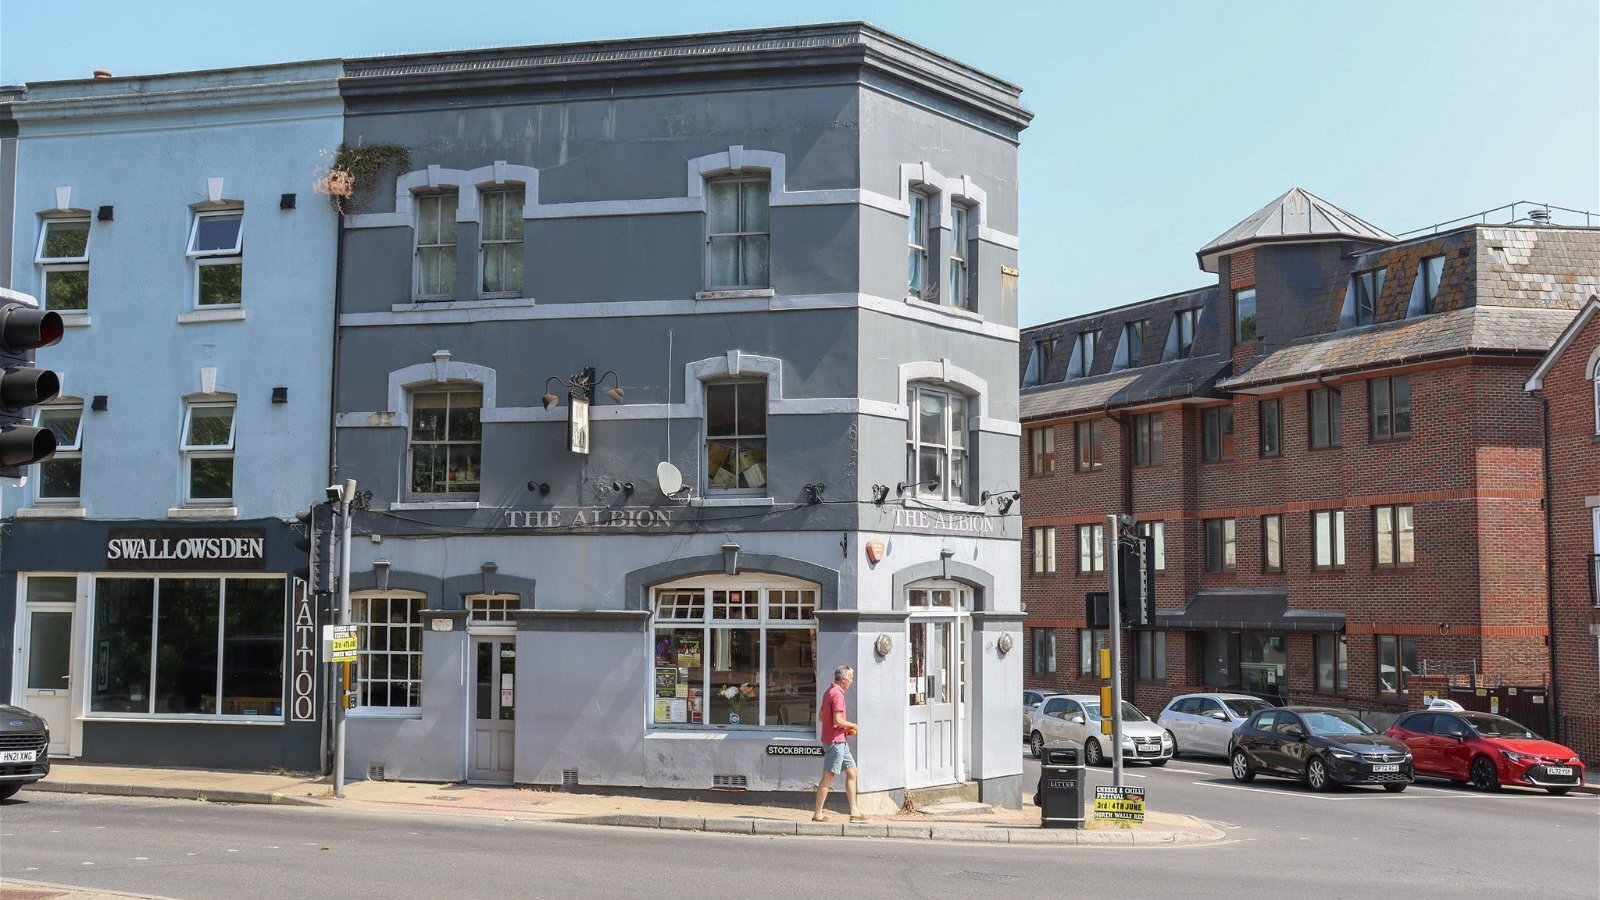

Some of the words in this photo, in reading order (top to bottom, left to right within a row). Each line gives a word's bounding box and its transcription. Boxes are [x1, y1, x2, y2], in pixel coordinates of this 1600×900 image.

[505, 510, 561, 528] THE
[572, 510, 673, 528] ALBION
[892, 507, 930, 528] THE
[934, 512, 994, 532] ALBION
[107, 537, 264, 559] SWALLOWSDEN
[295, 577, 314, 719] TATTOO
[768, 746, 822, 755] STOCKBRIDGE
[1126, 802, 1142, 811] JUNE
